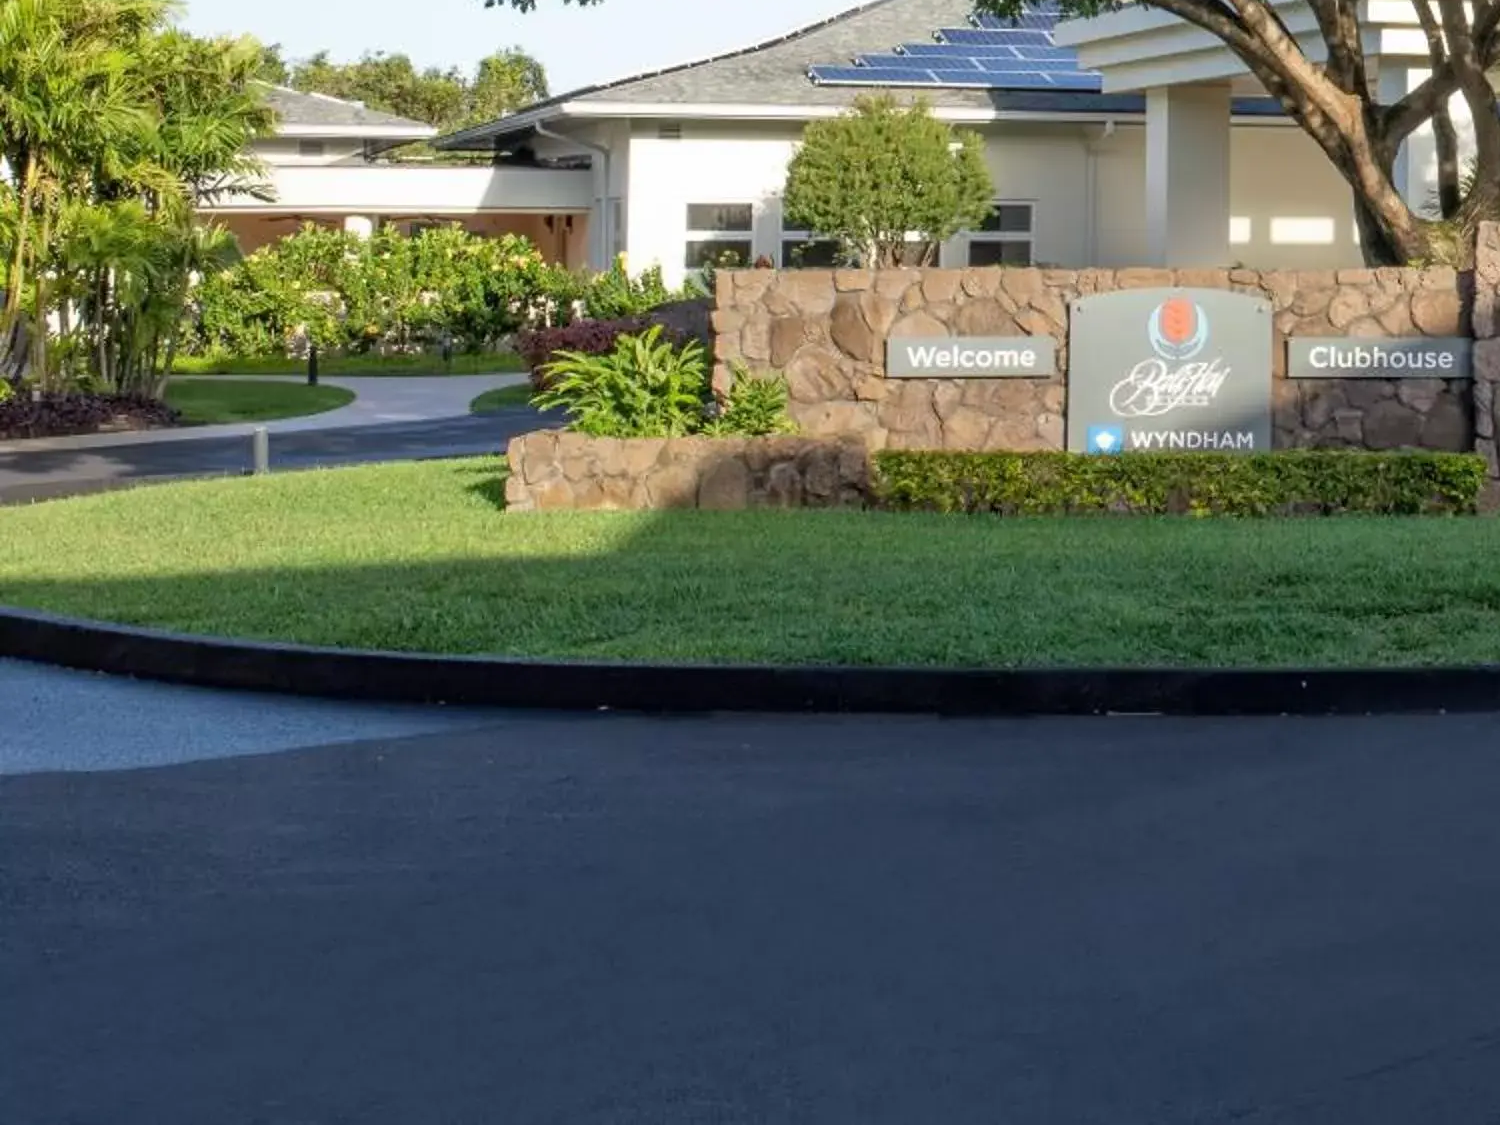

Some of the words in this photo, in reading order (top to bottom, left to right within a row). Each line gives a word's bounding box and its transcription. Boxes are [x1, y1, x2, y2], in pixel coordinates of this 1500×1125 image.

[906, 344, 1037, 368] Welcome
[1309, 346, 1454, 369] Clubhouse
[1130, 430, 1255, 450] WYNDHAM
